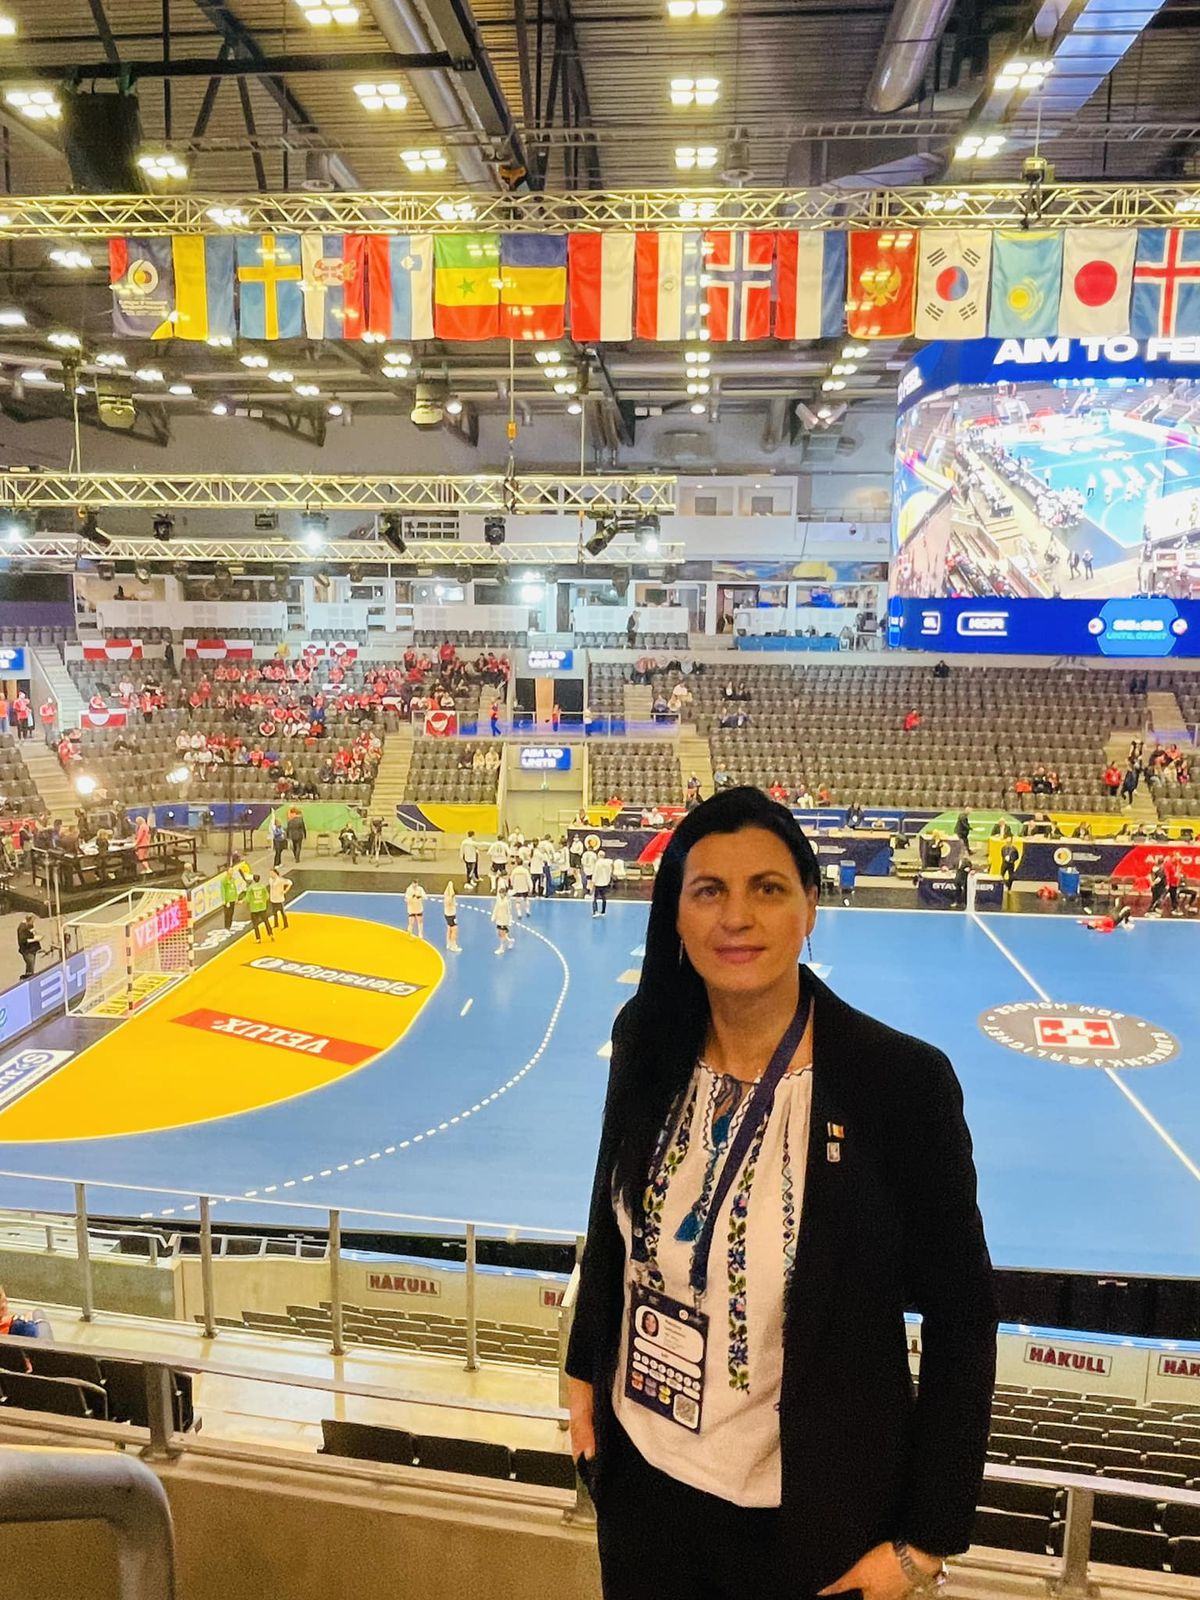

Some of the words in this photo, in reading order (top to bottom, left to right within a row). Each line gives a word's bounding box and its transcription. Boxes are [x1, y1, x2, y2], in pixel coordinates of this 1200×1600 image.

[993, 338, 1069, 365] AIM
[1079, 336, 1138, 362] TO
[134, 904, 182, 950] VELUX
[40, 944, 112, 1009] BYD
[282, 961, 418, 997] Gjensidige
[210, 1017, 330, 1054] VELUX
[369, 1274, 438, 1295] HÅKULL
[1029, 1346, 1107, 1374] HÅKULL
